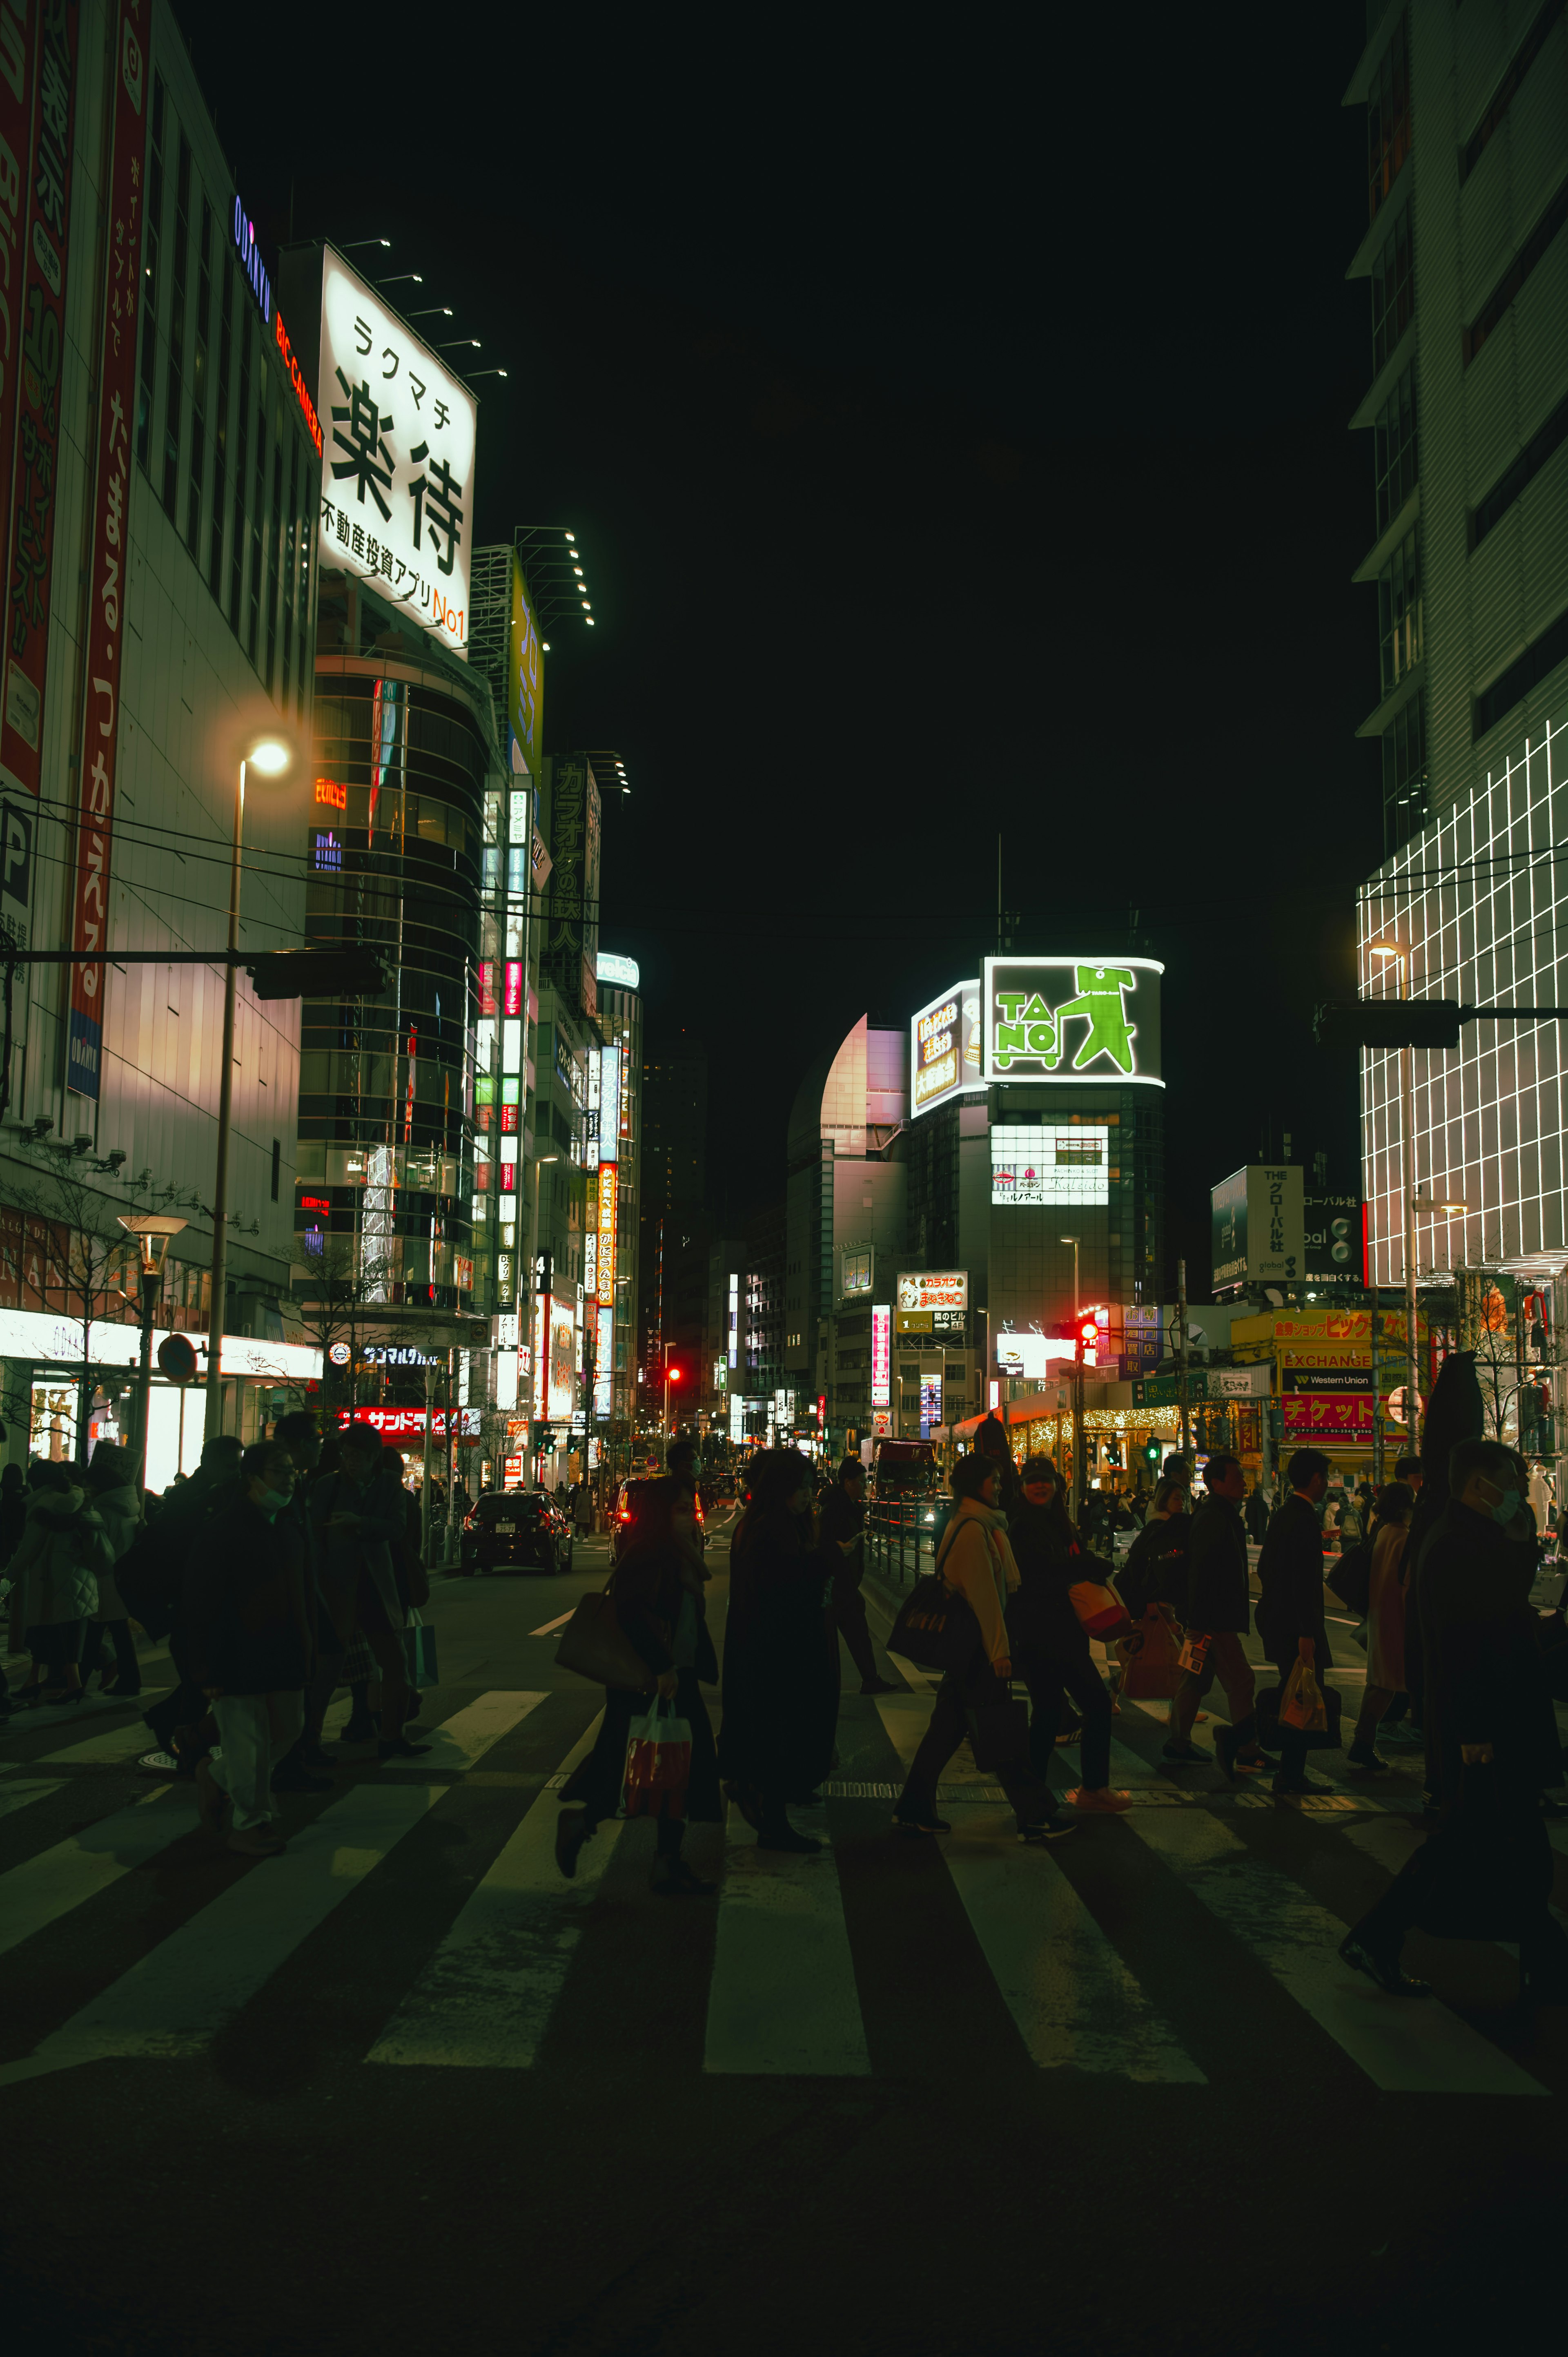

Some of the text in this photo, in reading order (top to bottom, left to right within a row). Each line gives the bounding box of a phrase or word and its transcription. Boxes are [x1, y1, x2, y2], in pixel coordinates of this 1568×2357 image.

[234, 195, 270, 323] ODAKYU
[276, 311, 322, 458] BIC CAMERA
[354, 316, 450, 430] ラクマチ
[330, 366, 463, 576] 楽待
[513, 807, 523, 840] アメミヤ
[551, 763, 585, 951] カラオケの鉄人
[998, 994, 1053, 1021] TA
[72, 1036, 97, 1074] ODAKYU
[998, 1024, 1056, 1051] NO
[601, 1059, 616, 1149] カラオケの鉄人
[1264, 1171, 1287, 1180] THE
[1011, 1193, 1043, 1202] ルノアール
[1270, 1182, 1284, 1252] グローバル社
[599, 1233, 612, 1302] かにさんまい
[926, 1277, 957, 1288] カラオケ
[919, 1291, 964, 1307] まねきねこ
[587, 1304, 595, 1340] カラオ
[1144, 1309, 1156, 1356] 専門店
[1126, 1309, 1138, 1373] お酒買取
[1285, 1355, 1372, 1367] EXCHANGE
[1310, 1376, 1368, 1384] Western Union
[1285, 1400, 1373, 1422] チケット
